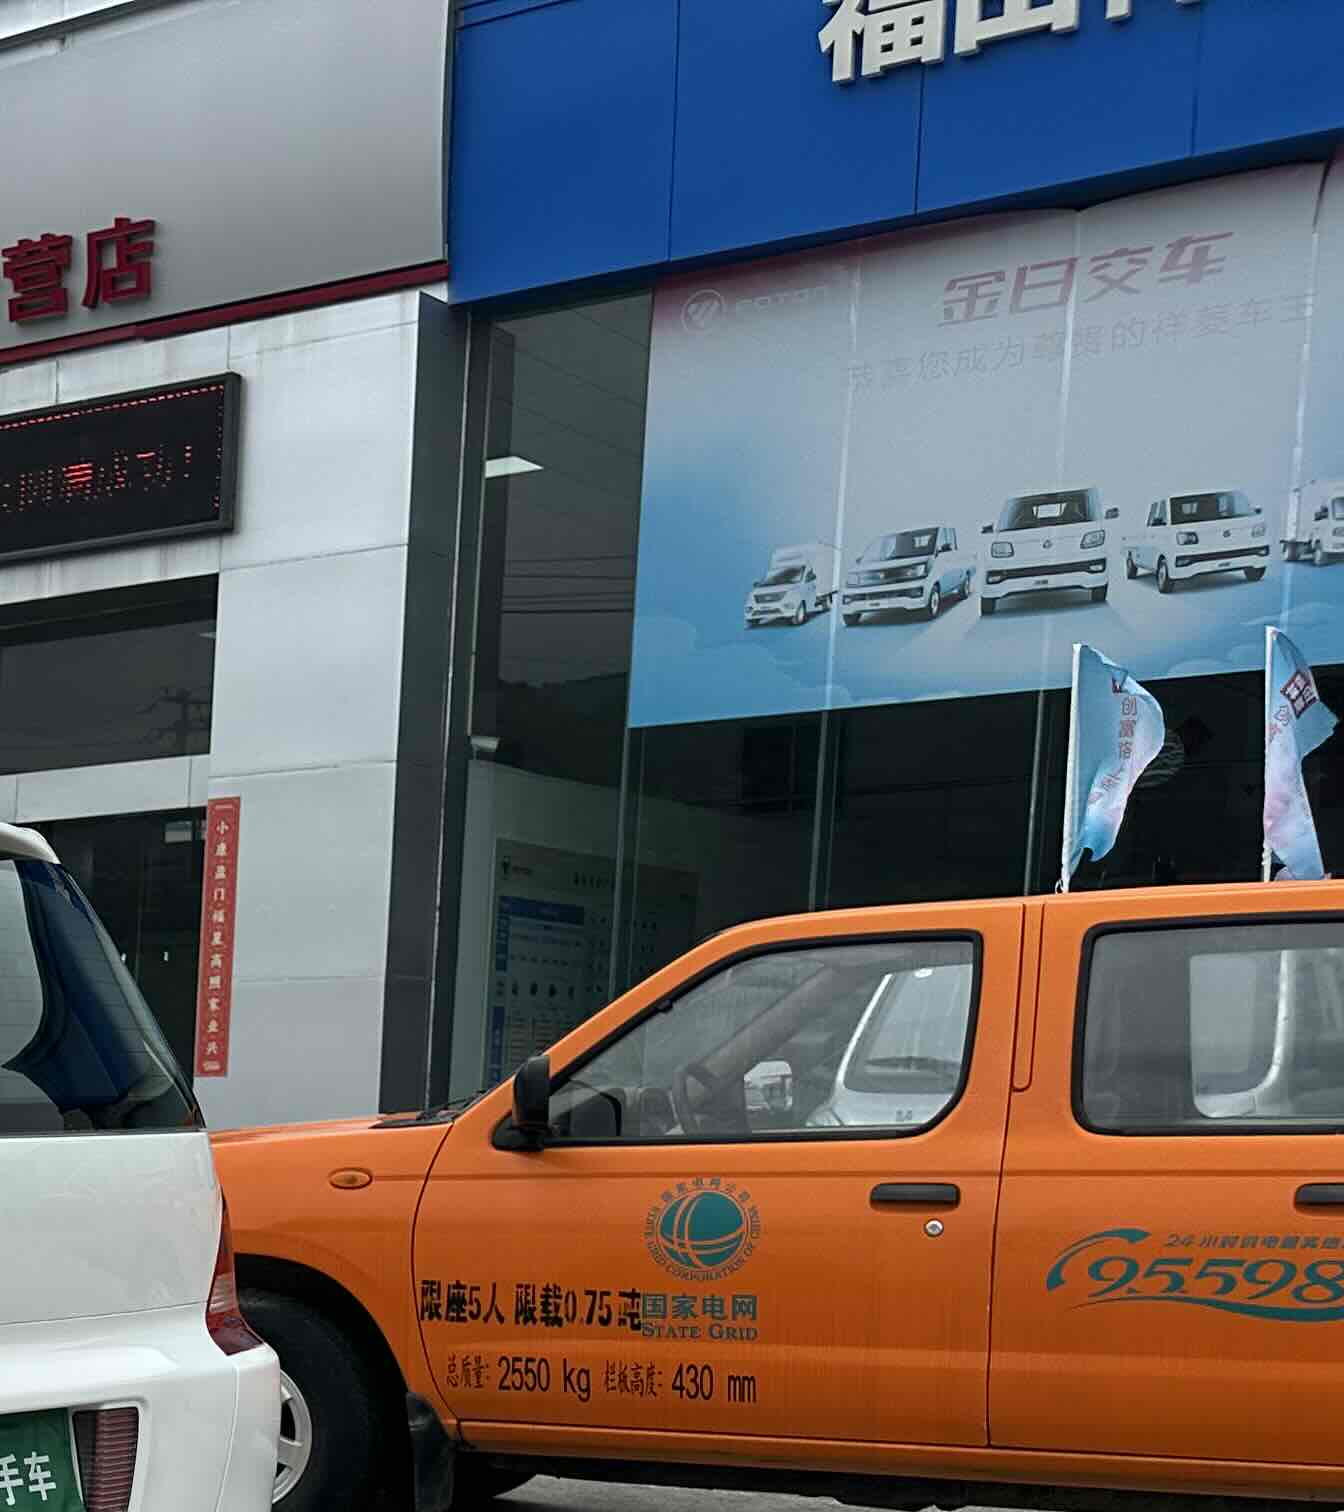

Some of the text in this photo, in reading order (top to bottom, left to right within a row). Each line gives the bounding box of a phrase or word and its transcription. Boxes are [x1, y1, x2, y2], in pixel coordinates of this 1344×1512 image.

[420, 1279, 505, 1325] 限座5人
[1087, 1255, 1344, 1304] 95598
[642, 1290, 758, 1320] 国家电网
[498, 1356, 551, 1392] 2550
[563, 1358, 591, 1402] kg
[672, 1362, 714, 1400] 430
[727, 1375, 757, 1403] mm
